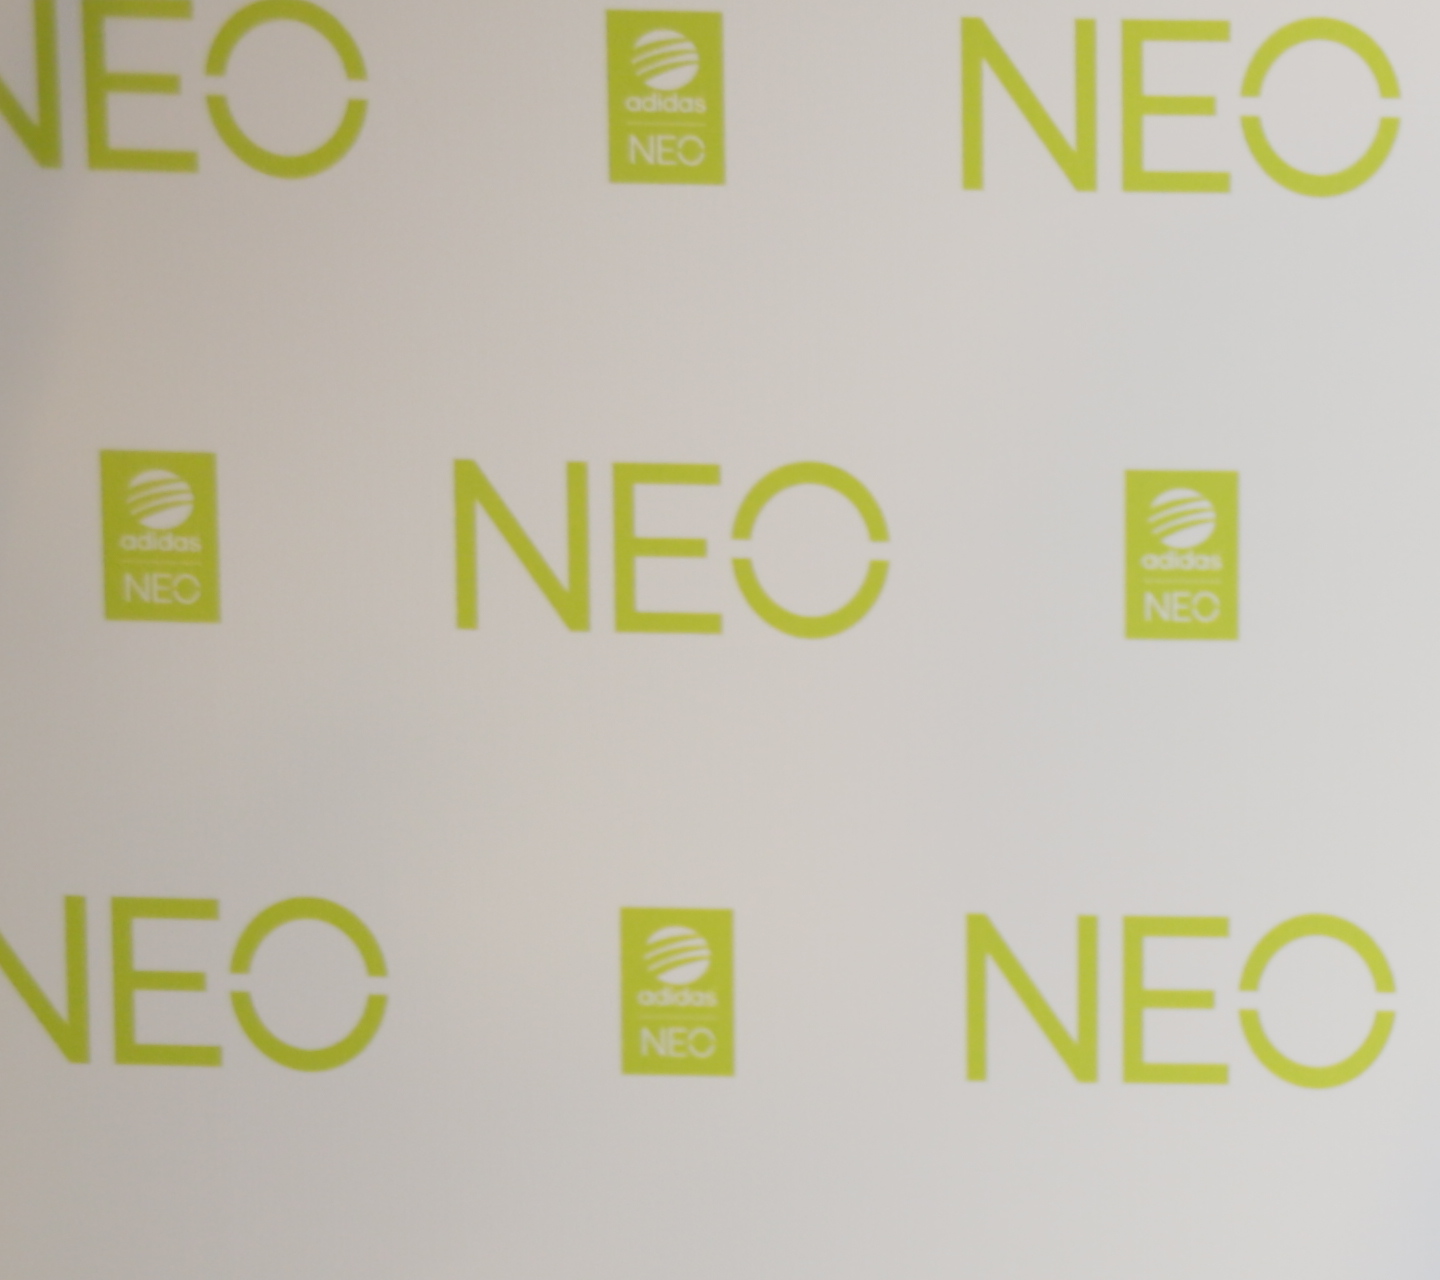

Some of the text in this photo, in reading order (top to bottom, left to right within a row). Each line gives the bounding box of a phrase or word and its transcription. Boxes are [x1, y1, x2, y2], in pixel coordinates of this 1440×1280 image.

[623, 91, 707, 113] adidas
[961, 16, 1399, 197] NEO
[627, 132, 706, 166] NEO
[117, 531, 201, 554] adidas
[453, 459, 888, 639] NEO
[1140, 548, 1221, 570] adidas
[122, 572, 200, 606] NEO
[1143, 588, 1219, 622] NEO
[637, 984, 717, 1006] adidas
[966, 913, 1394, 1089] NEO
[640, 1024, 715, 1058] NEO
